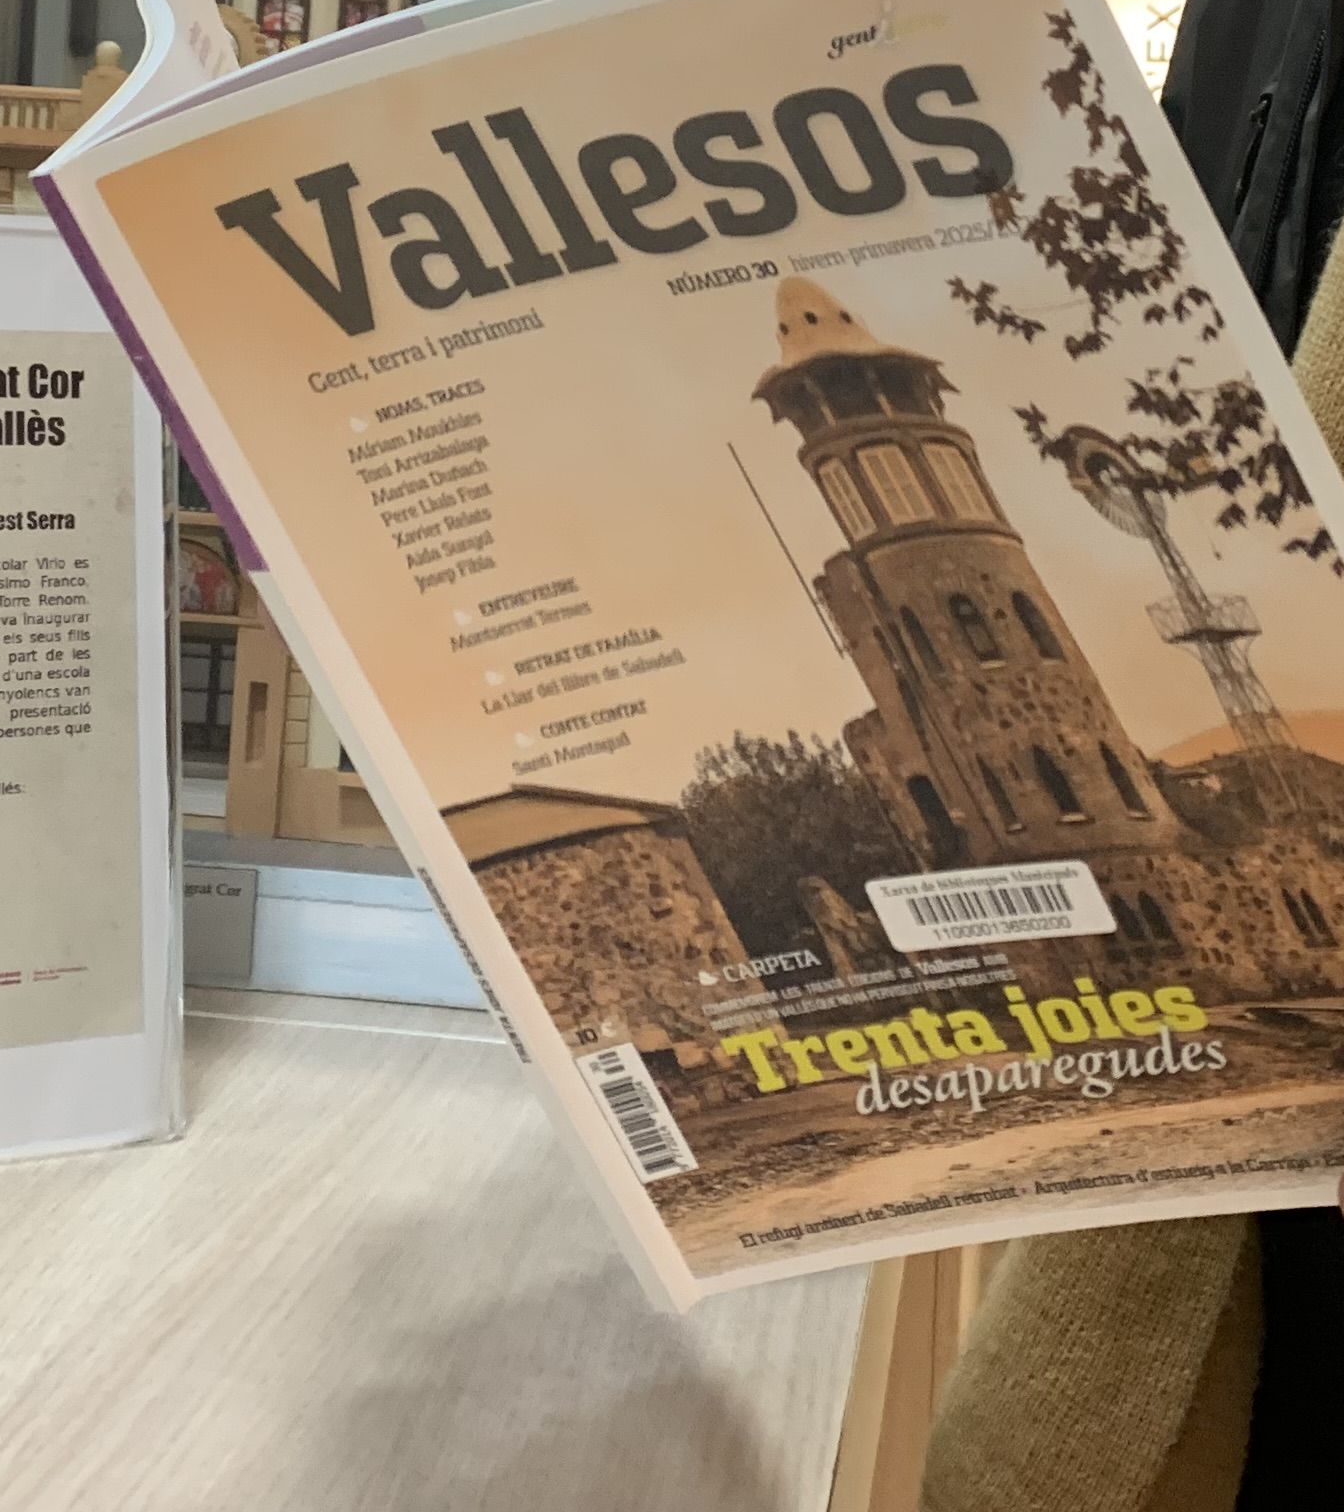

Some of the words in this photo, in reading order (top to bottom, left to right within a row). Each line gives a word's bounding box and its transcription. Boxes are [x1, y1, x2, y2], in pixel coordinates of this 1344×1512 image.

[215, 62, 1015, 338] Vallesos
[667, 265, 751, 296] NÚMERO
[753, 259, 778, 279] 30
[787, 234, 935, 272] hivern-primavera
[368, 346, 425, 375] terra
[425, 337, 437, 357] i
[439, 307, 545, 359] patrimoni
[28, 363, 85, 399] Cor
[426, 379, 485, 407] TRACES
[27, 510, 76, 531] Serra
[74, 558, 89, 569] es
[1, 616, 16, 626] va
[24, 612, 90, 627] inaugurar
[3, 633, 22, 644] els
[30, 632, 61, 643] seus
[68, 628, 90, 641] fills
[9, 649, 37, 665] part
[46, 648, 63, 661] de
[73, 647, 90, 659] les
[722, 949, 822, 983] CARPETA
[721, 1006, 1007, 1093] Trenta
[1004, 976, 1209, 1063] joies
[856, 1023, 1229, 1115] desaparegudes
[1034, 1172, 1136, 1196] Arquitectura
[739, 1233, 757, 1248] El
[759, 1224, 804, 1244] refugi
[866, 1208, 885, 1222] de
[884, 1194, 955, 1219] Sabadell
[955, 1186, 1020, 1207] retrobat
